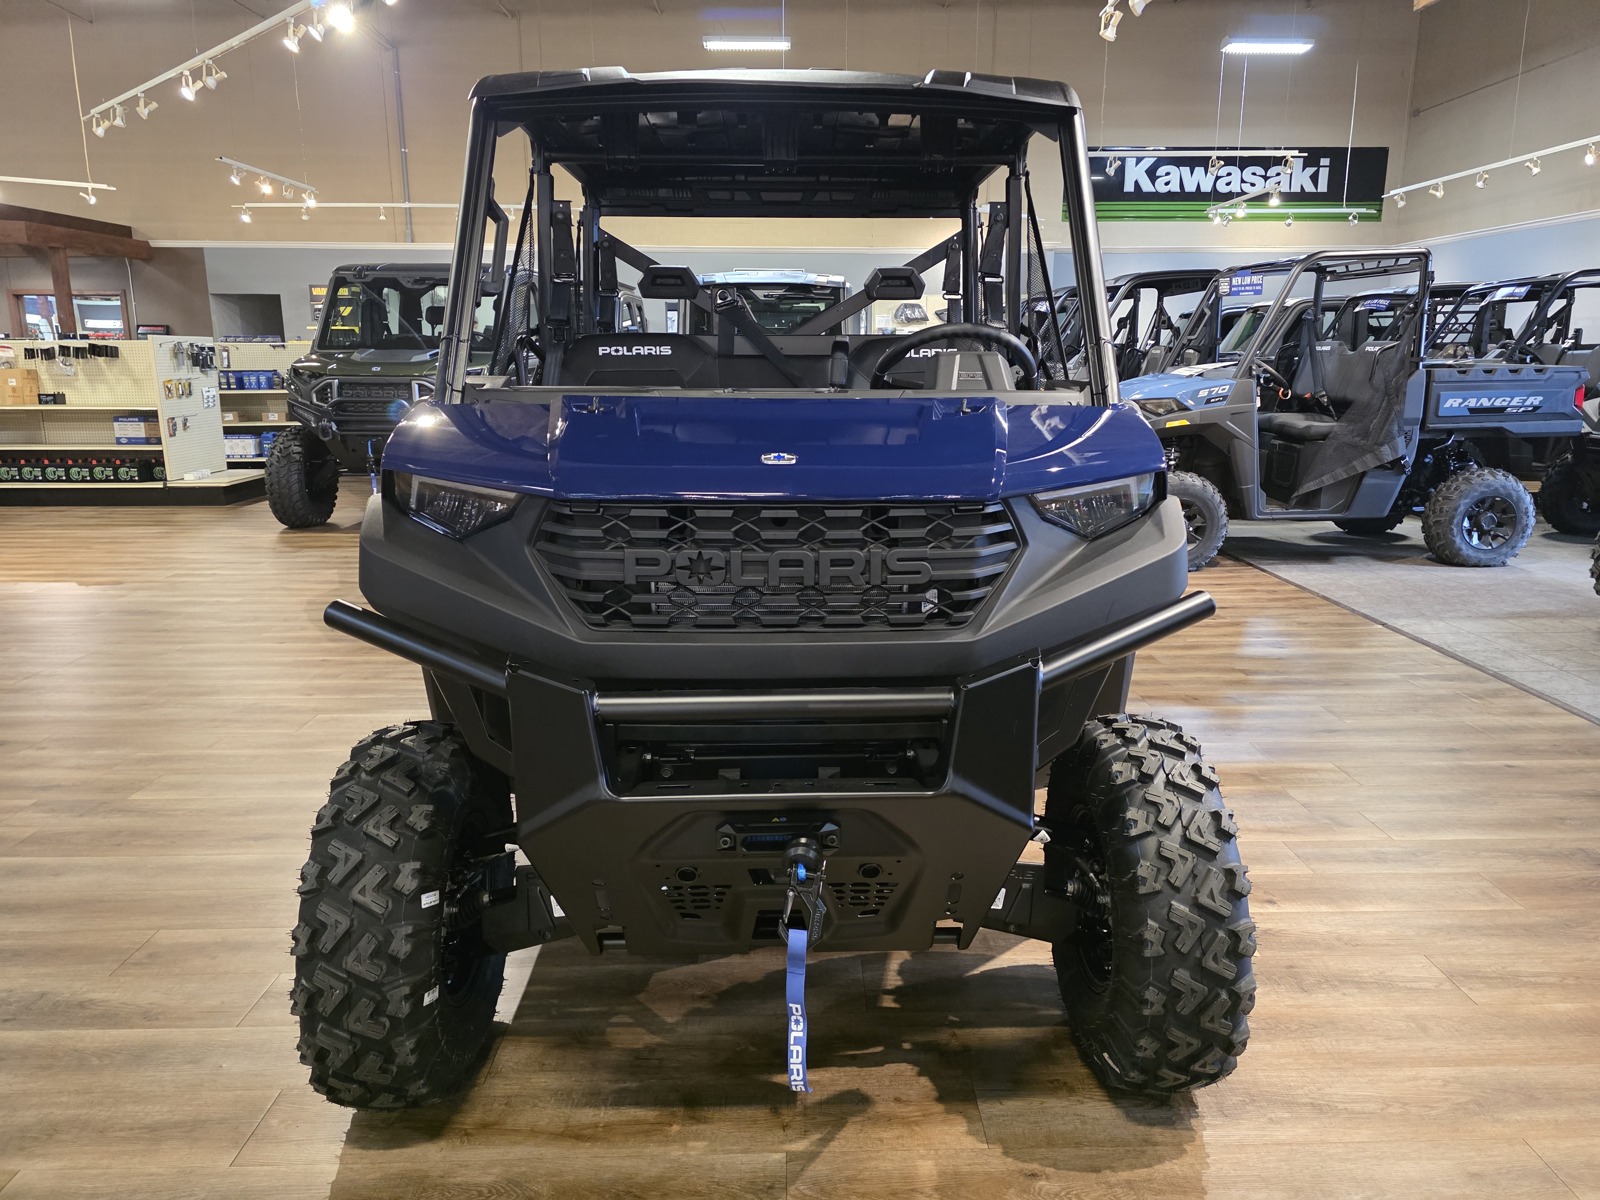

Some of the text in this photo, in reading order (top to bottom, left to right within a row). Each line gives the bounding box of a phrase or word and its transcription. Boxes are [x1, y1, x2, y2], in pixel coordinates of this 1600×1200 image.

[1123, 157, 1331, 193] Kawasaki
[1251, 274, 1263, 284] PRICE
[598, 346, 673, 356] POLARIS
[1443, 396, 1544, 408] RANGER
[623, 548, 933, 587] POLARIS
[788, 1003, 806, 1092] POLARIS
